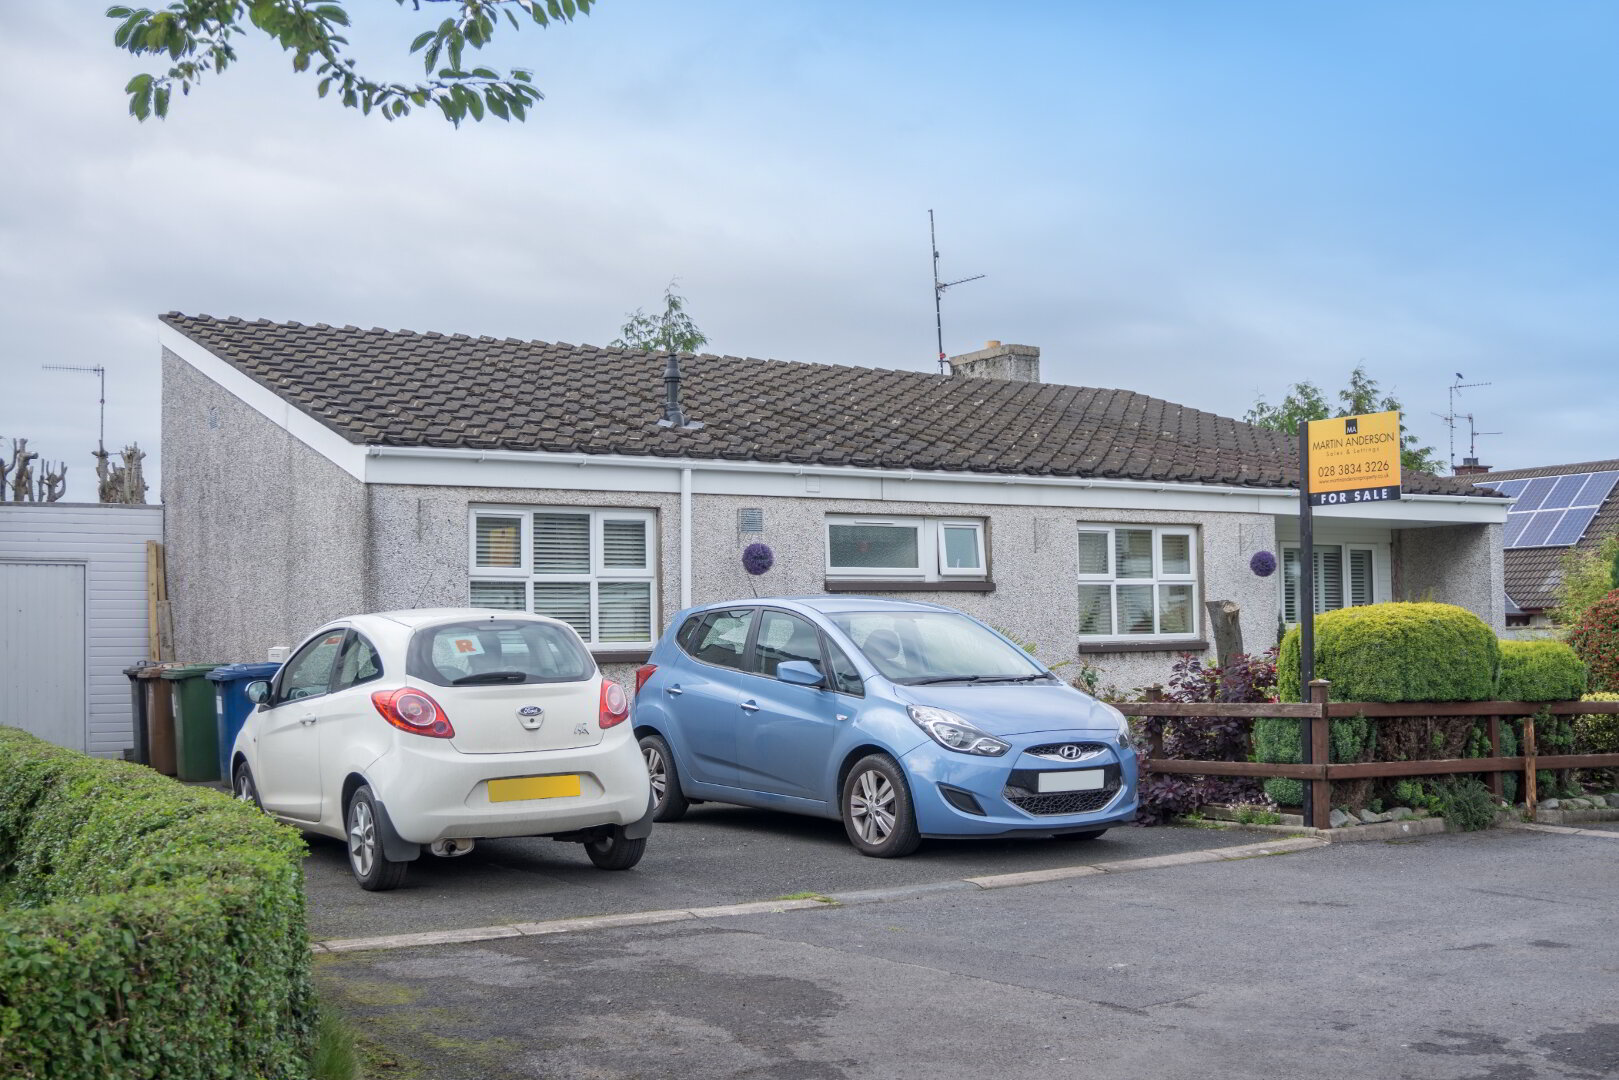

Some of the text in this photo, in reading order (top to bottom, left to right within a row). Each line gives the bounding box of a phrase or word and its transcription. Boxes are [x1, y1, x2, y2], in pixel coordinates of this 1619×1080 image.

[1312, 432, 1395, 451] MARTIN ANDERSON
[1318, 460, 1390, 478] 028 3834 3226
[1321, 489, 1388, 504] FOR SALE
[455, 639, 477, 653] R
